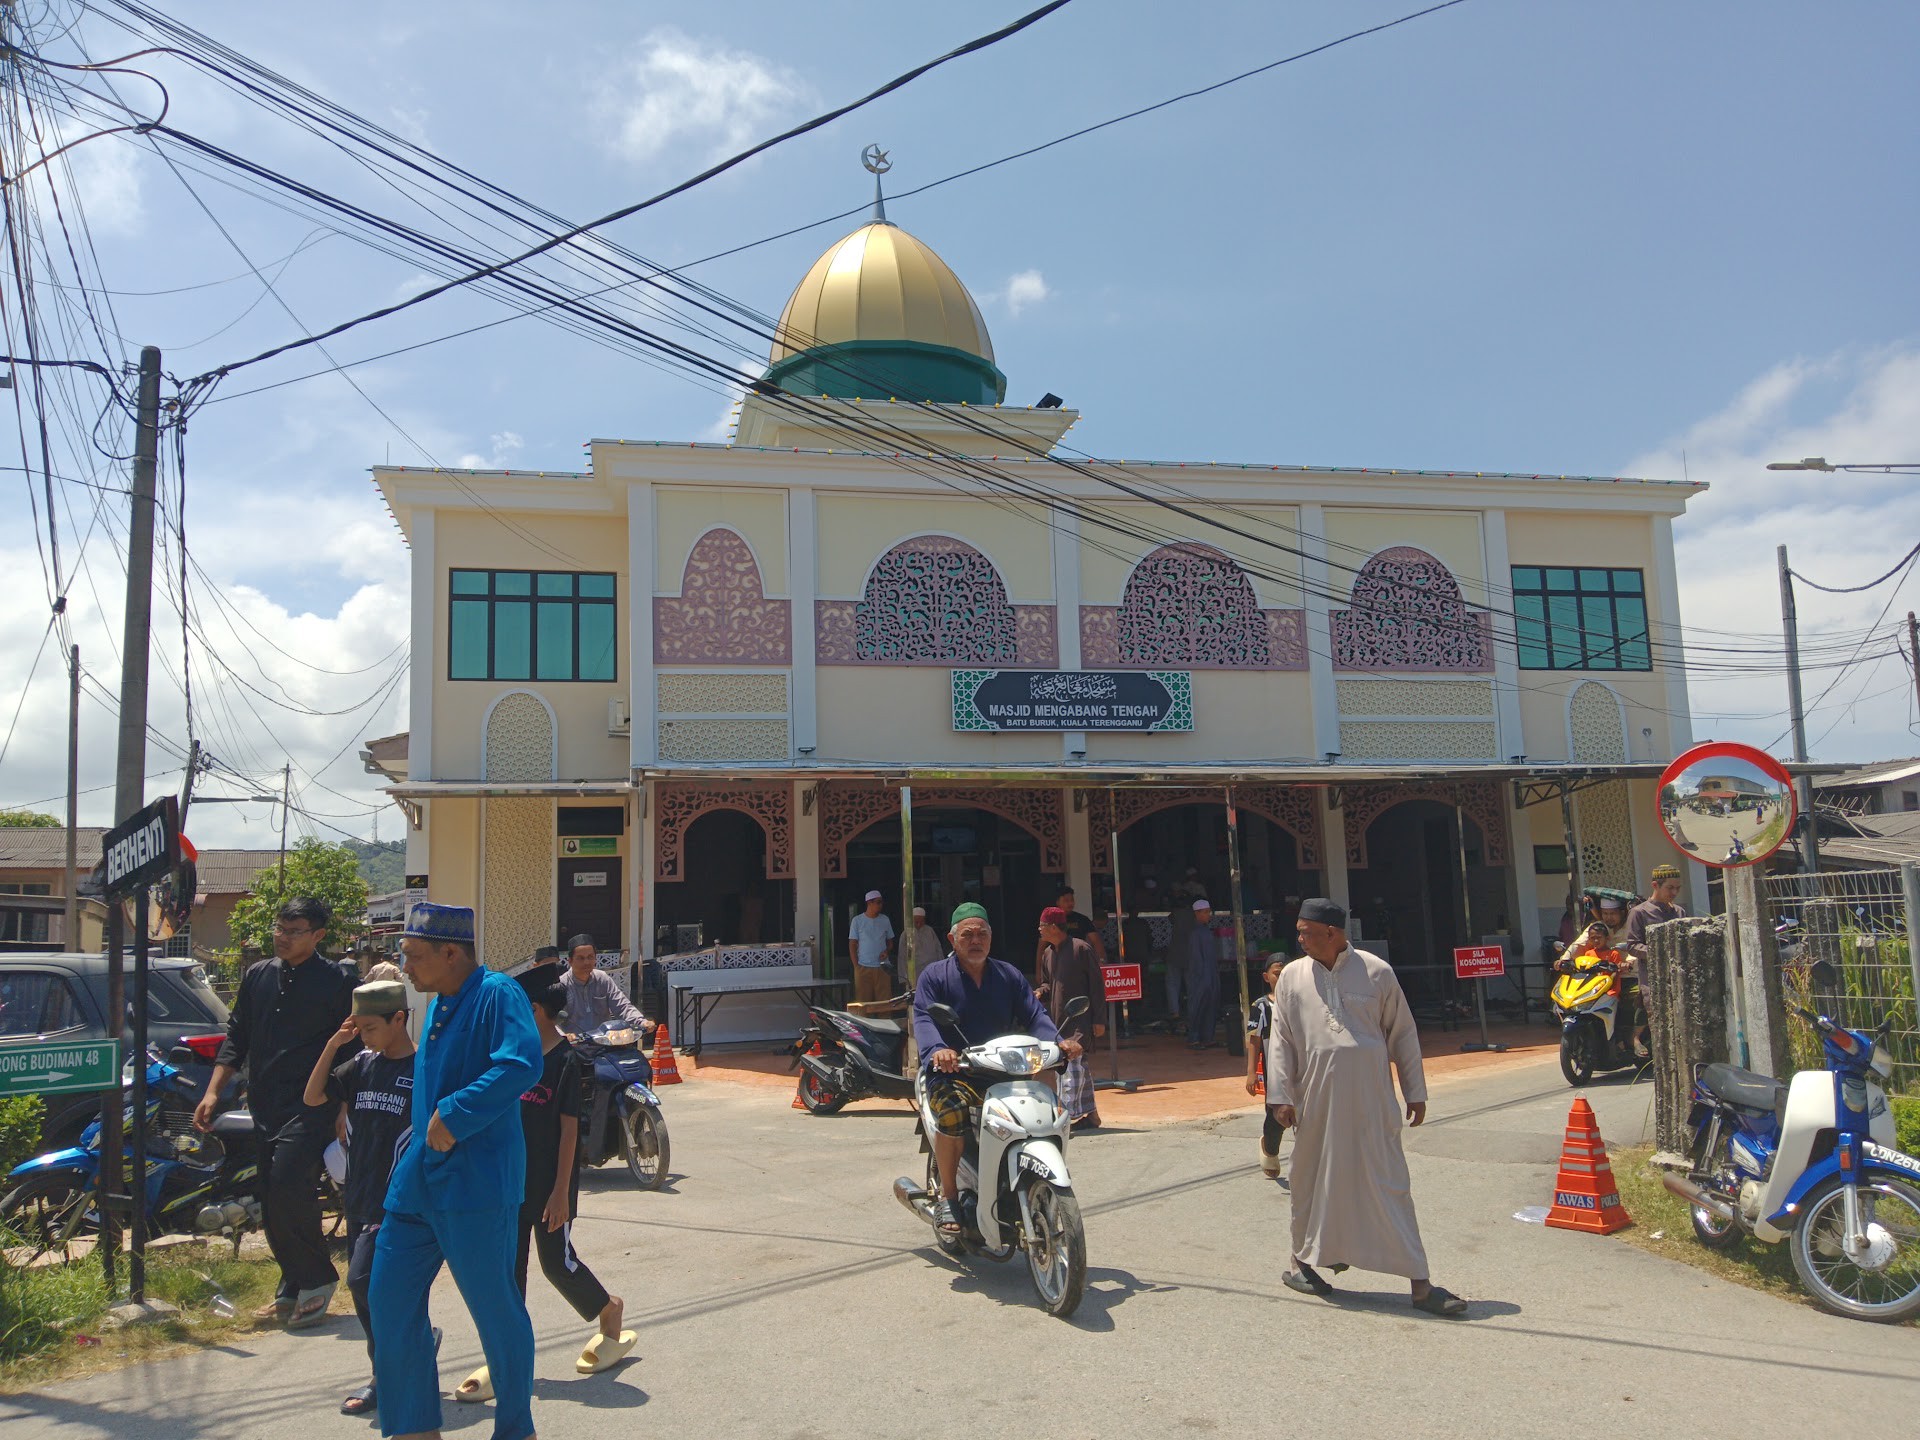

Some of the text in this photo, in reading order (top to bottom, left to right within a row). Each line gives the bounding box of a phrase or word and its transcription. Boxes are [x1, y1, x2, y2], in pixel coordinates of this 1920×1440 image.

[989, 704, 1158, 717] MASJID MENGABANG TENGAH
[1006, 719, 1143, 728] BATU BURUK, KUALA TERENGGANU
[107, 815, 165, 885] BERHENTI
[1472, 950, 1486, 958] SILA
[1459, 957, 1499, 967] KOSONGKAN
[1106, 969, 1121, 978] SILA
[1104, 977, 1137, 988] ONGKAN
[0, 1050, 99, 1073] ONG BUDIMAN 4B
[356, 1091, 407, 1108] TERENGGANU
[379, 1102, 403, 1115] LEAGUE
[1019, 1155, 1050, 1179] TAT 7053
[1557, 1193, 1595, 1209] AWAS
